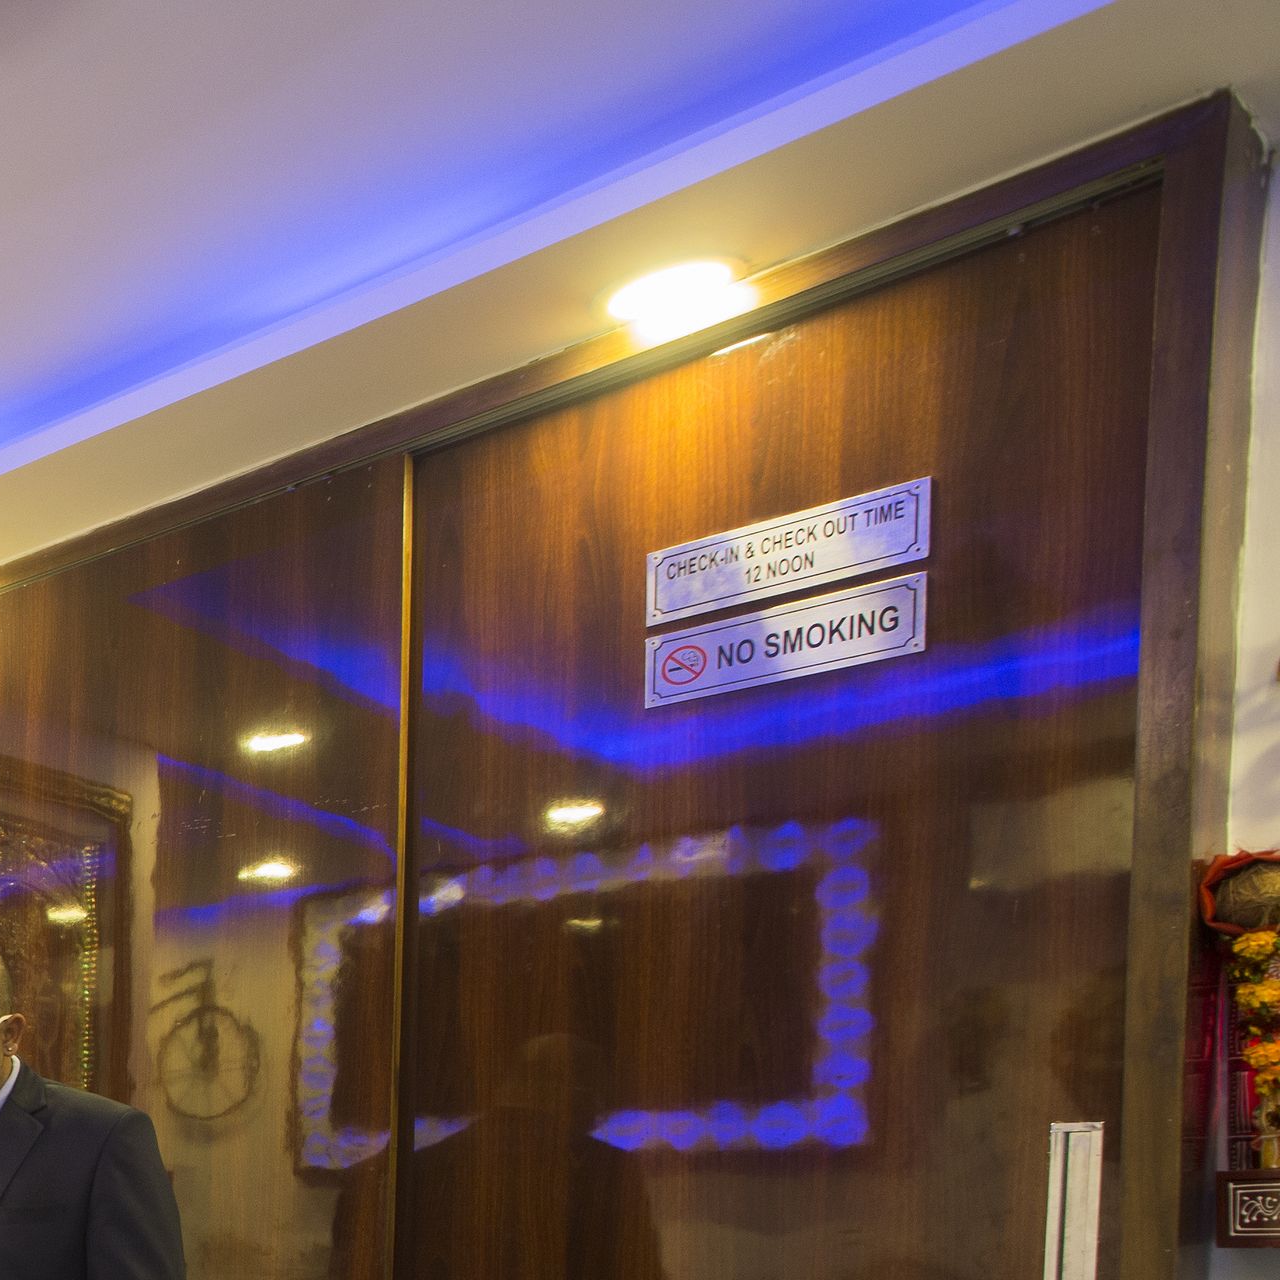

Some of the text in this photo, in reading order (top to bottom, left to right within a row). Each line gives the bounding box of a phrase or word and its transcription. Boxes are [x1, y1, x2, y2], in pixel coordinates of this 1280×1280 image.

[667, 500, 905, 580] CHECK-IN & CHECK OUT TIME
[744, 551, 815, 585] 12 NOON
[716, 605, 900, 670] NO SMOKING
